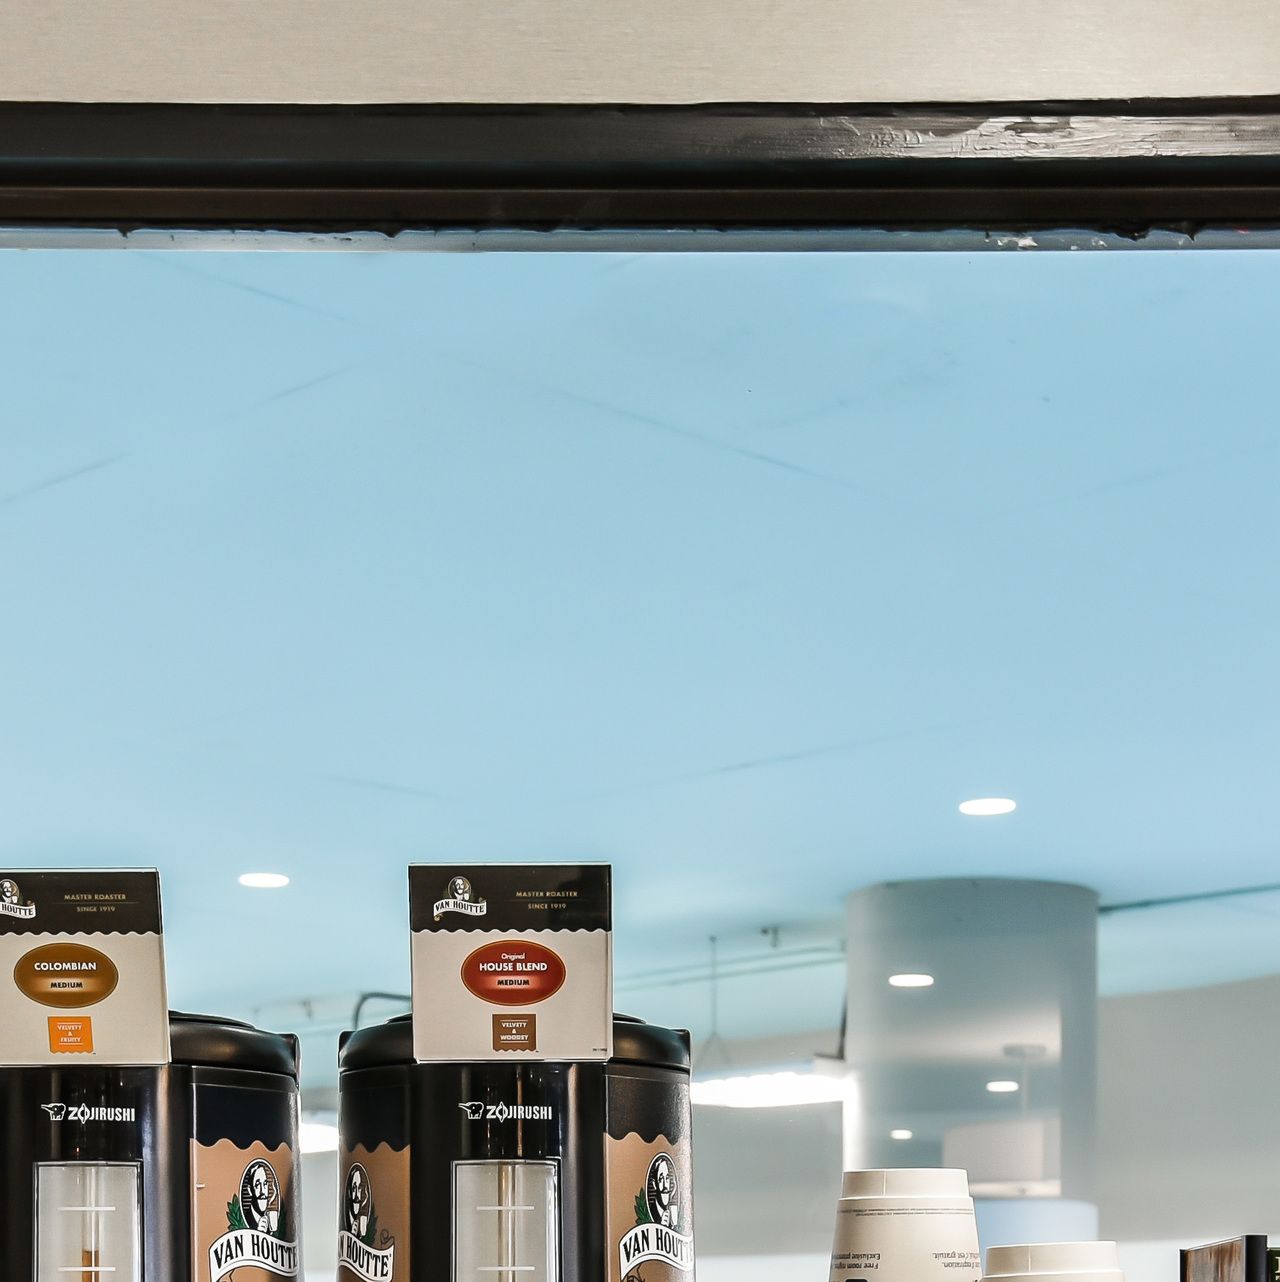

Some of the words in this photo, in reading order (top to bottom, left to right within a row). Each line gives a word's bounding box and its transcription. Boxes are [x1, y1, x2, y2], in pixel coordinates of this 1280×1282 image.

[2, 904, 33, 916] HOUTTE
[435, 901, 450, 912] VAN
[453, 901, 484, 913] HOUTTE
[501, 953, 525, 961] Original
[34, 962, 96, 970] COLOMBIAN
[480, 963, 513, 971] HOUSE
[517, 963, 547, 971] BLEND
[68, 1103, 135, 1124] ZOJIRUSHI
[487, 1102, 552, 1122] ZOJIRUSHI
[623, 1228, 649, 1262] VAN
[214, 1235, 244, 1269] VAN
[347, 1236, 389, 1277] HOUTTE
[855, 1253, 881, 1261] Exclusive
